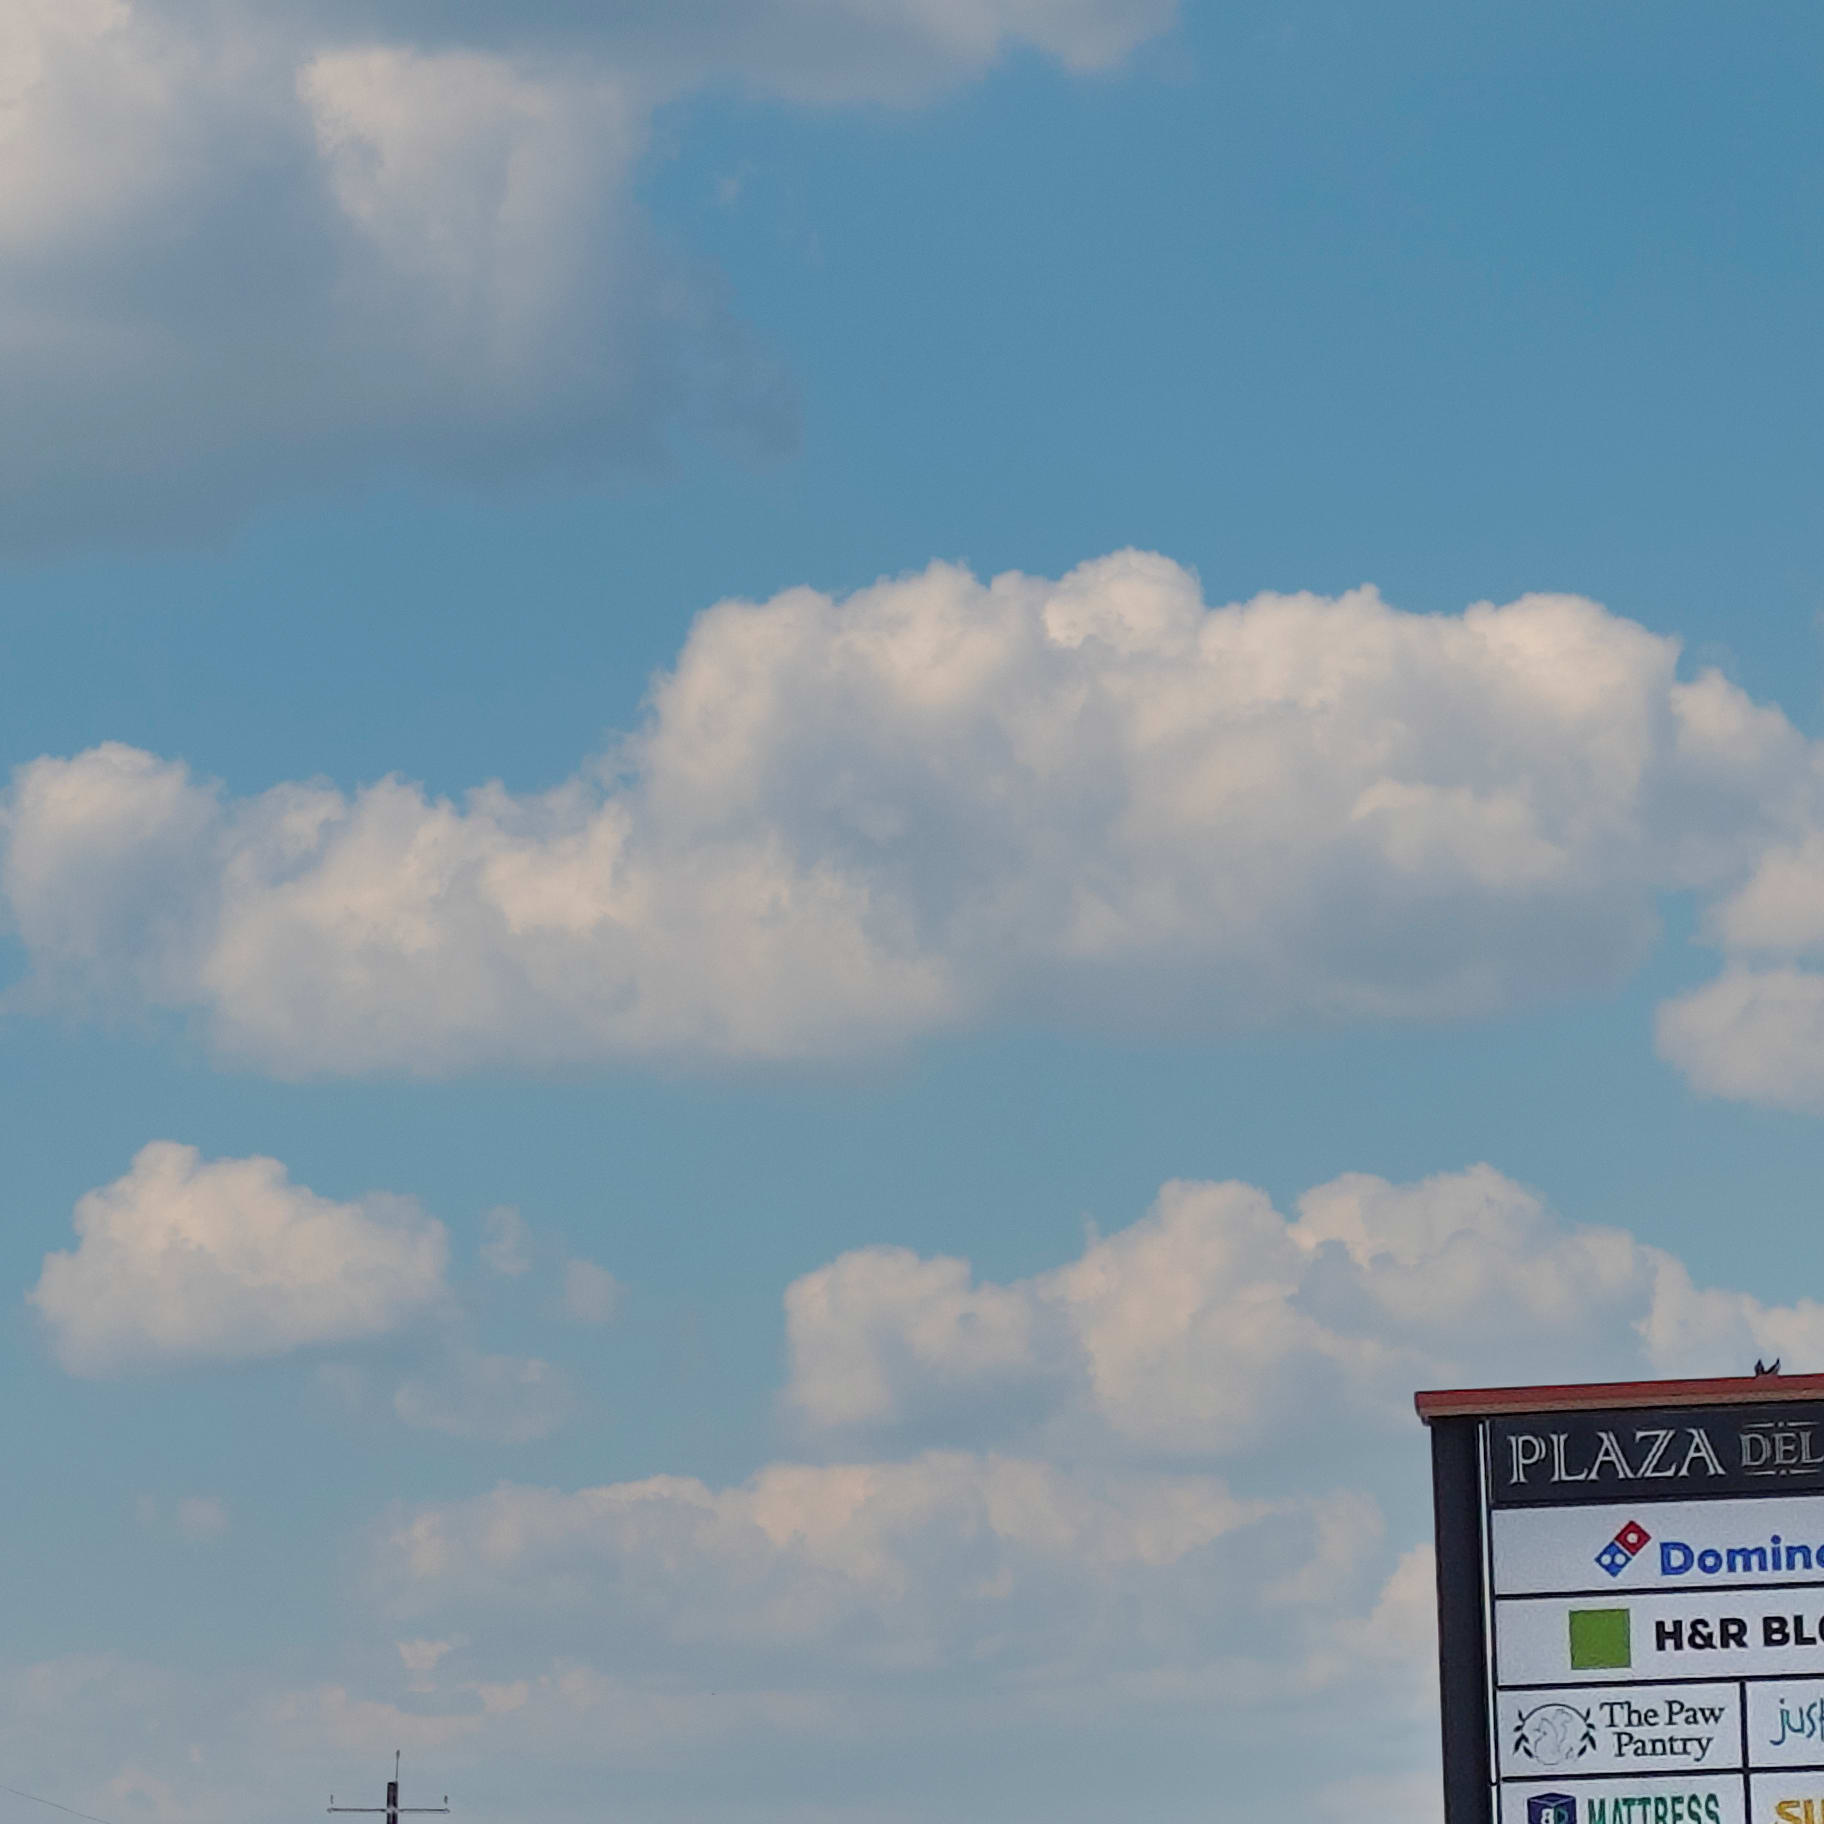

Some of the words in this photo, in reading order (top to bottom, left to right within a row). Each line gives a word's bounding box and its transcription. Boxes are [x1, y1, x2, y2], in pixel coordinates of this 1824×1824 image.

[1506, 1427, 1726, 1484] PLAZA
[1655, 1617, 1748, 1652] H&R
[1599, 1700, 1659, 1728] The
[1663, 1700, 1726, 1727] Paw
[1612, 1731, 1714, 1762] Pantry
